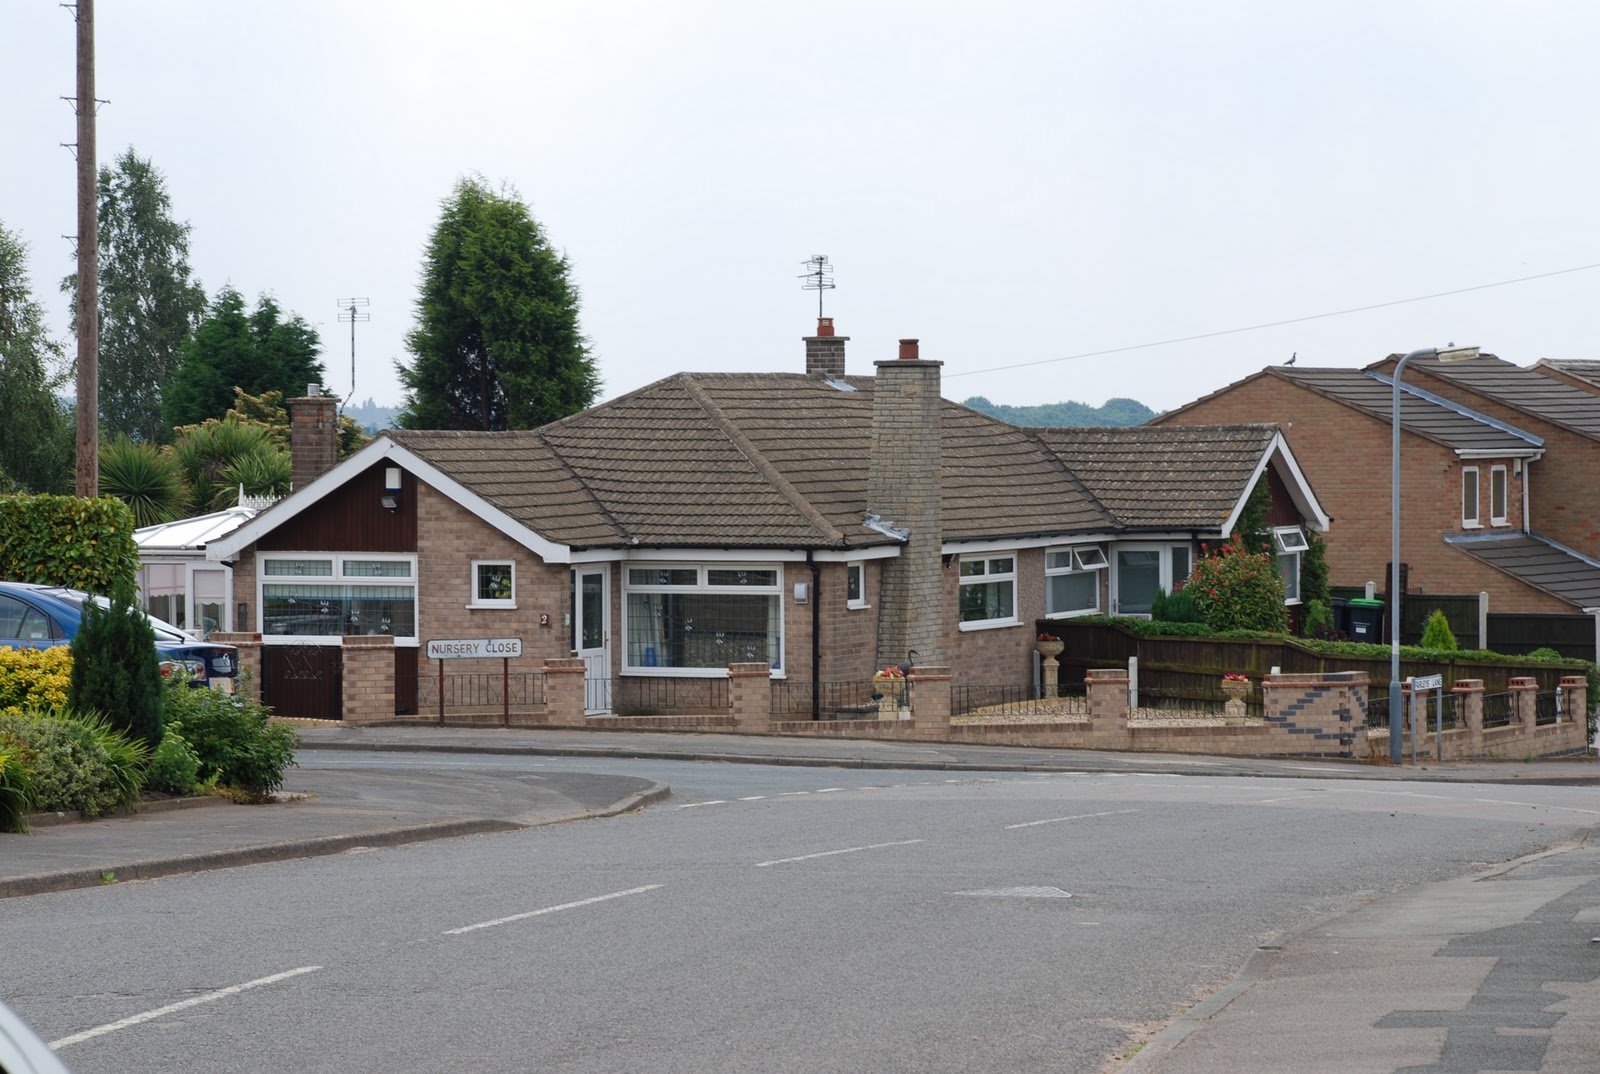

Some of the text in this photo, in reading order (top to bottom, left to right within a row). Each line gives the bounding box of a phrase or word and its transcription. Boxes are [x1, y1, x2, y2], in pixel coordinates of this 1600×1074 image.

[541, 614, 547, 624] 2
[431, 642, 518, 654] NURSERY CLOSE
